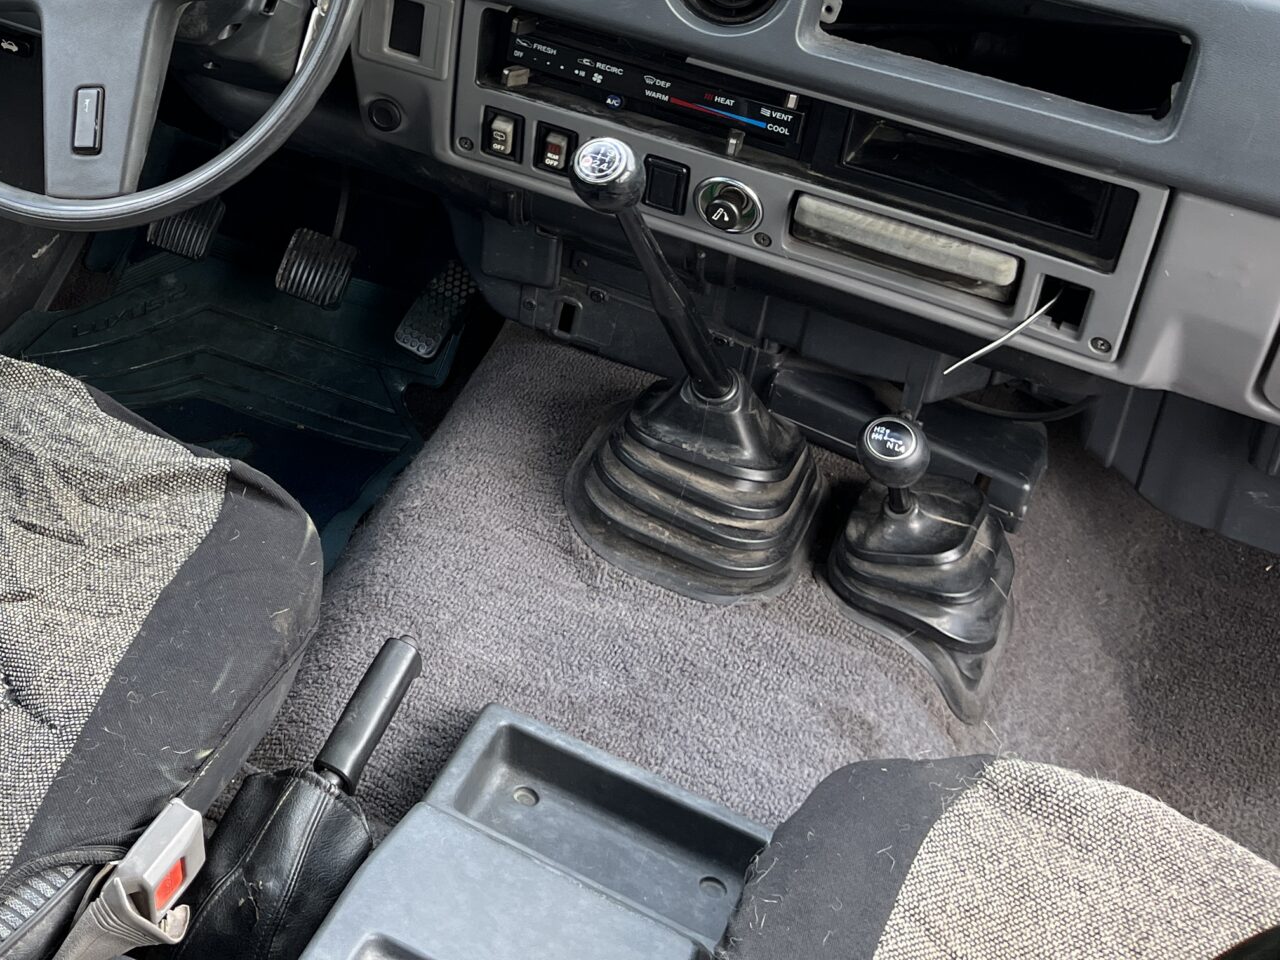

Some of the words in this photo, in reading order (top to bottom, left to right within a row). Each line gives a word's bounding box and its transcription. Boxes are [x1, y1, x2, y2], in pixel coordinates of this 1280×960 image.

[513, 50, 524, 58] OFF
[533, 43, 557, 55] FRESH
[596, 62, 624, 75] RECIRC
[655, 79, 671, 89] DEF
[645, 89, 669, 102] WARM
[714, 95, 736, 107] HEAT
[606, 97, 620, 107] A/C
[771, 110, 793, 122] VENT
[766, 123, 790, 136] COOL
[492, 143, 506, 152] OFF
[545, 158, 559, 167] OFF
[873, 426, 886, 434] H2
[871, 433, 883, 441] H4
[886, 441, 894, 450] N
[894, 444, 906, 454] L4
